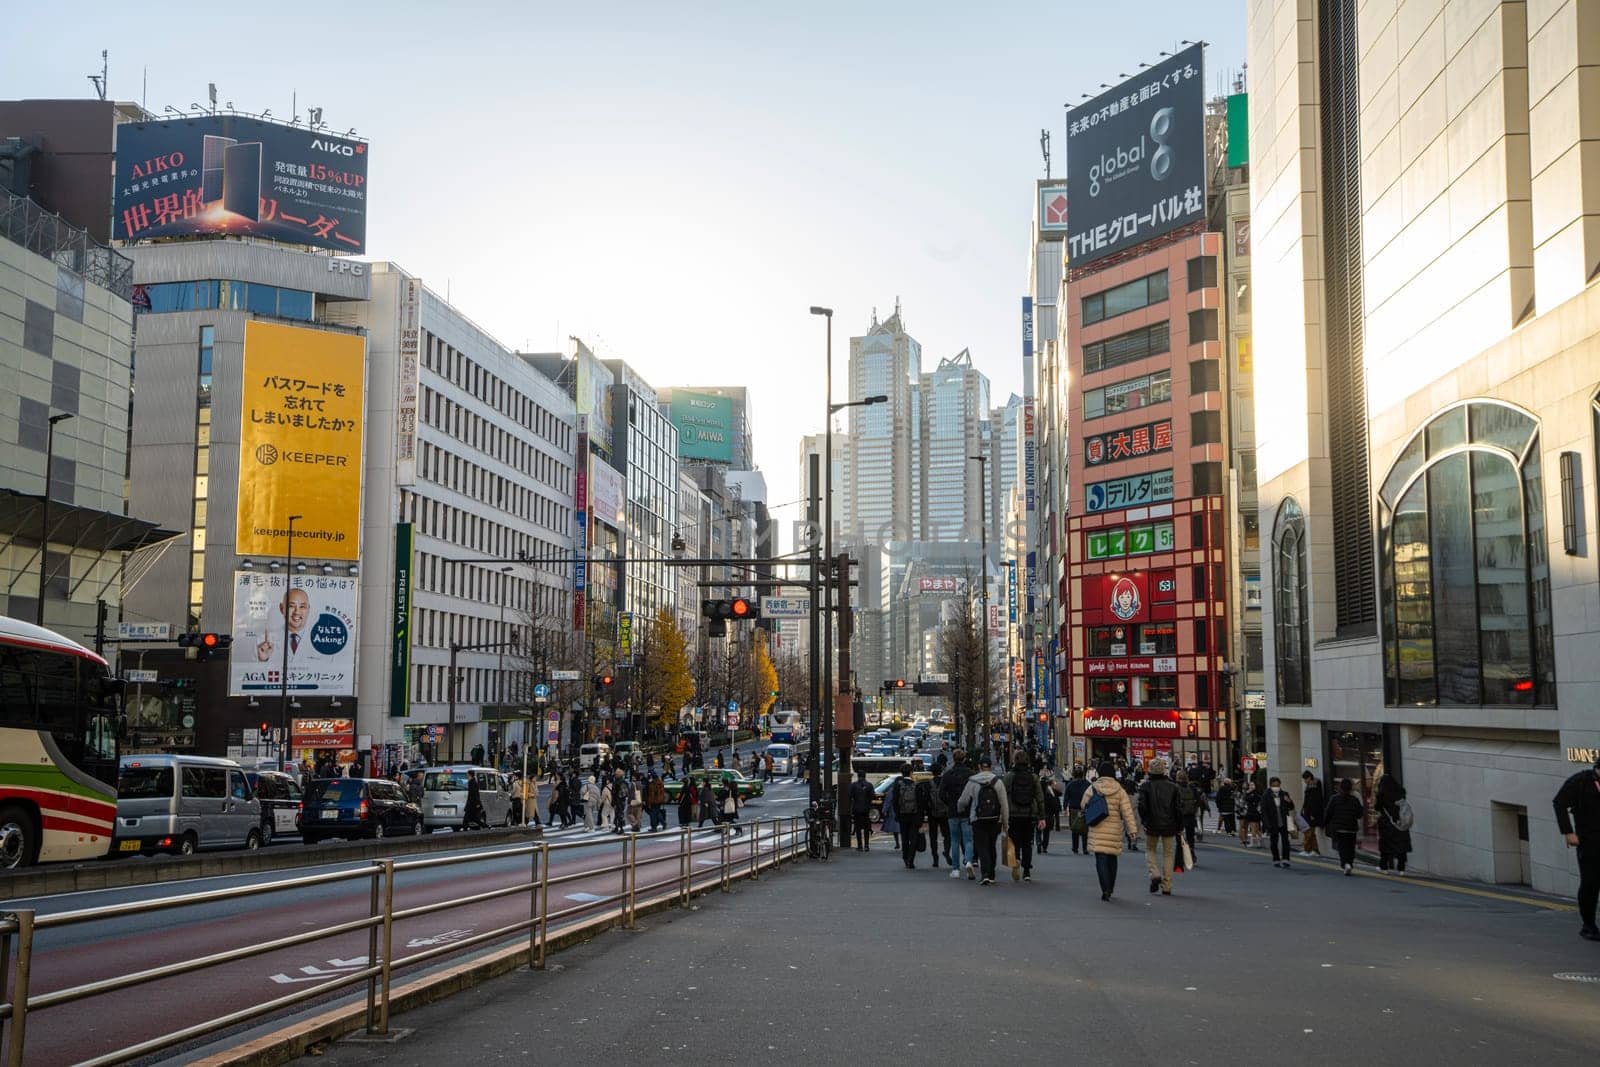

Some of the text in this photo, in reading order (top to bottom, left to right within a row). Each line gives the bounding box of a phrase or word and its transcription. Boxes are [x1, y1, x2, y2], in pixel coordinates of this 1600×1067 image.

[1069, 63, 1199, 138] 未来の不動産を面白くする。
[311, 139, 354, 157] AIKO
[131, 151, 185, 180] AIKO
[1089, 135, 1145, 198] global
[121, 186, 205, 239] 世界的
[260, 196, 361, 248] リーダー
[1069, 185, 1203, 259] THEグローバル社
[327, 259, 364, 276] FPG
[283, 395, 325, 412] 忘れて
[250, 409, 355, 432] しまいましたか?
[697, 431, 724, 443] MIWA
[1112, 421, 1172, 459] 大黒屋
[282, 451, 347, 467] KEEPER
[1025, 441, 1035, 486] SHINJUKU
[1108, 478, 1151, 505] デルタ
[254, 526, 346, 543] keepersecurity.jp
[1096, 532, 1148, 555] レイク
[922, 578, 954, 590] やまや
[313, 634, 346, 646] Asking!
[242, 672, 266, 681] AGA
[1084, 714, 1177, 731] Wendy's First Kitchen
